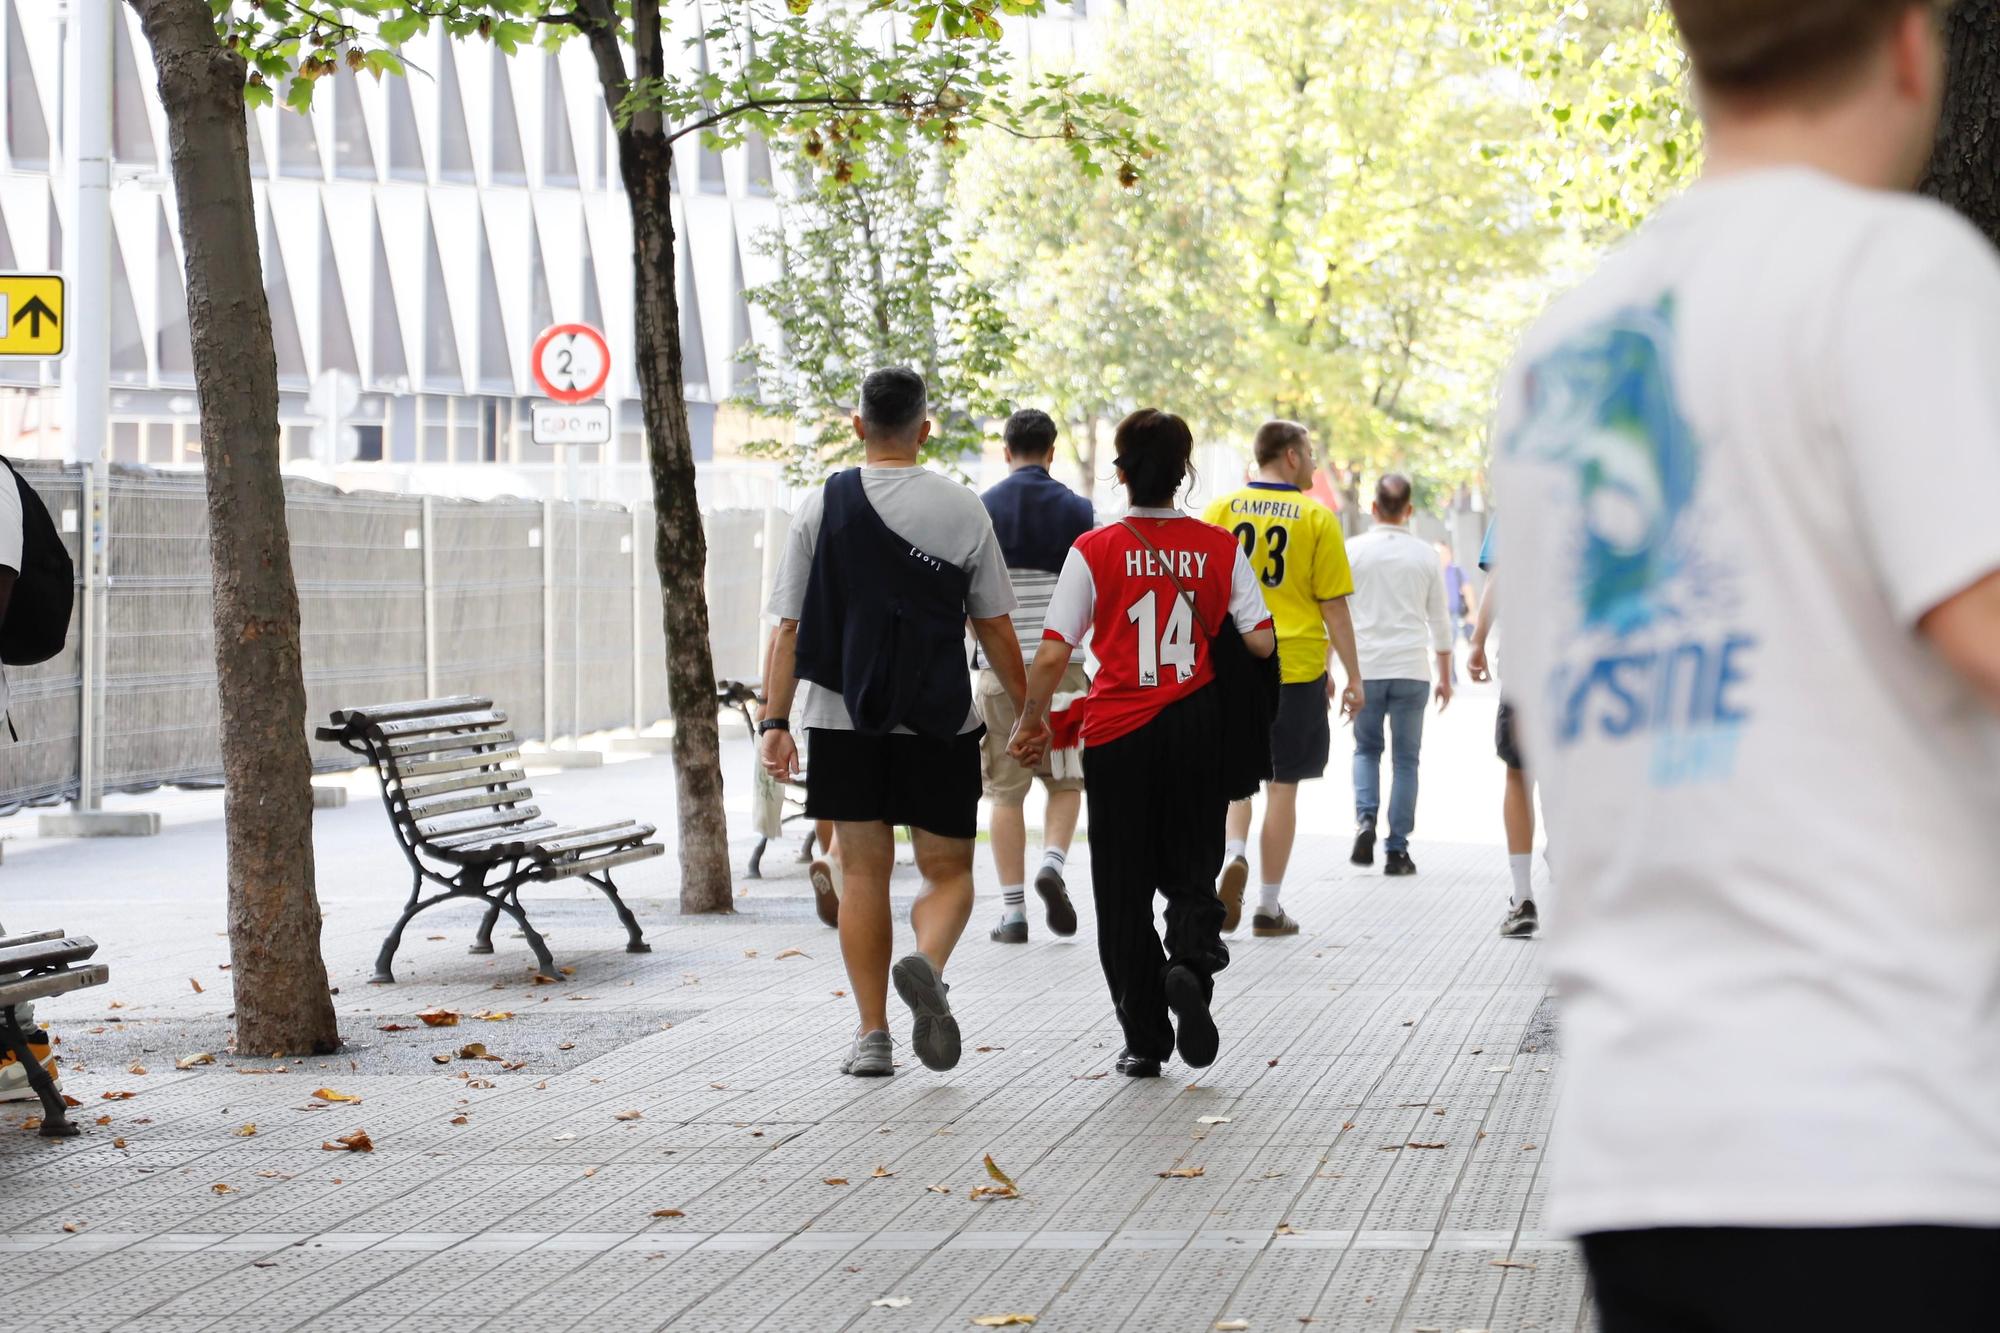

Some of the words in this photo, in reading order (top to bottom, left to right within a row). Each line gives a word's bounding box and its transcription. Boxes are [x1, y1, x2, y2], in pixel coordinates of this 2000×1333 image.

[557, 349, 573, 375] 2
[587, 421, 602, 432] m
[1231, 499, 1300, 520] CAMPBELL
[1125, 550, 1208, 578] HENRY
[1127, 589, 1196, 687] 14
